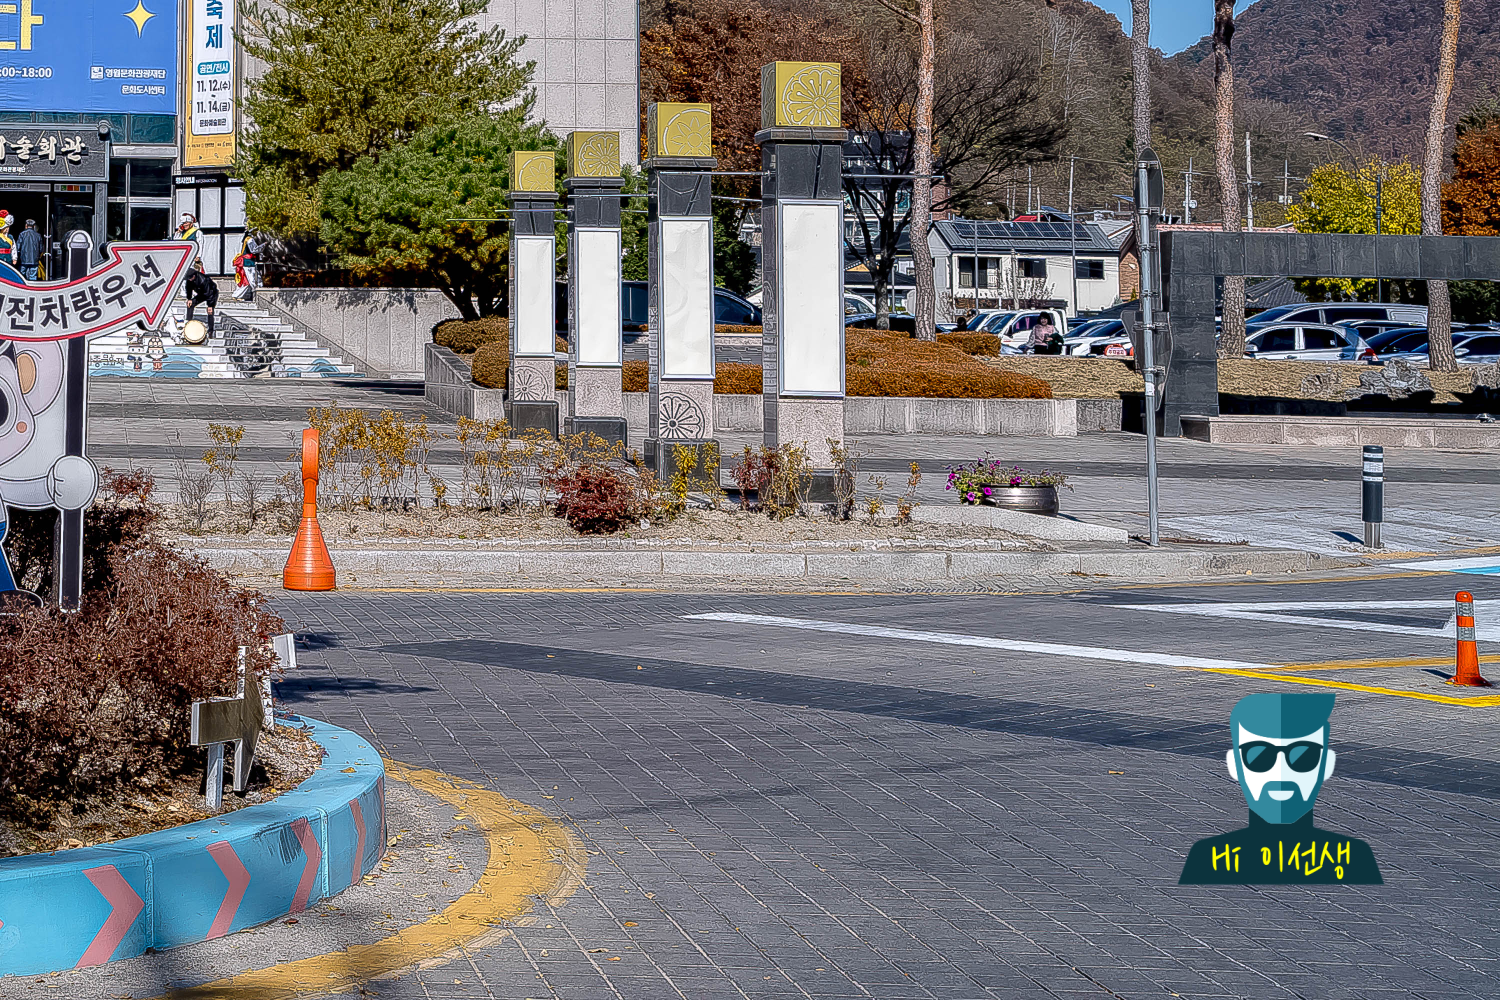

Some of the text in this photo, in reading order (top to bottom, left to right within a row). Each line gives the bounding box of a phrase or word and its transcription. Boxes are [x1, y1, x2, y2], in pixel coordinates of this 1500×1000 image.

[105, 68, 166, 79] 영월문화관광재단
[199, 62, 229, 74] 공연/전시
[121, 85, 166, 95] 문화도시센터
[197, 79, 231, 92] 11. 12.(수)
[197, 101, 231, 113] 11. 14.(금)
